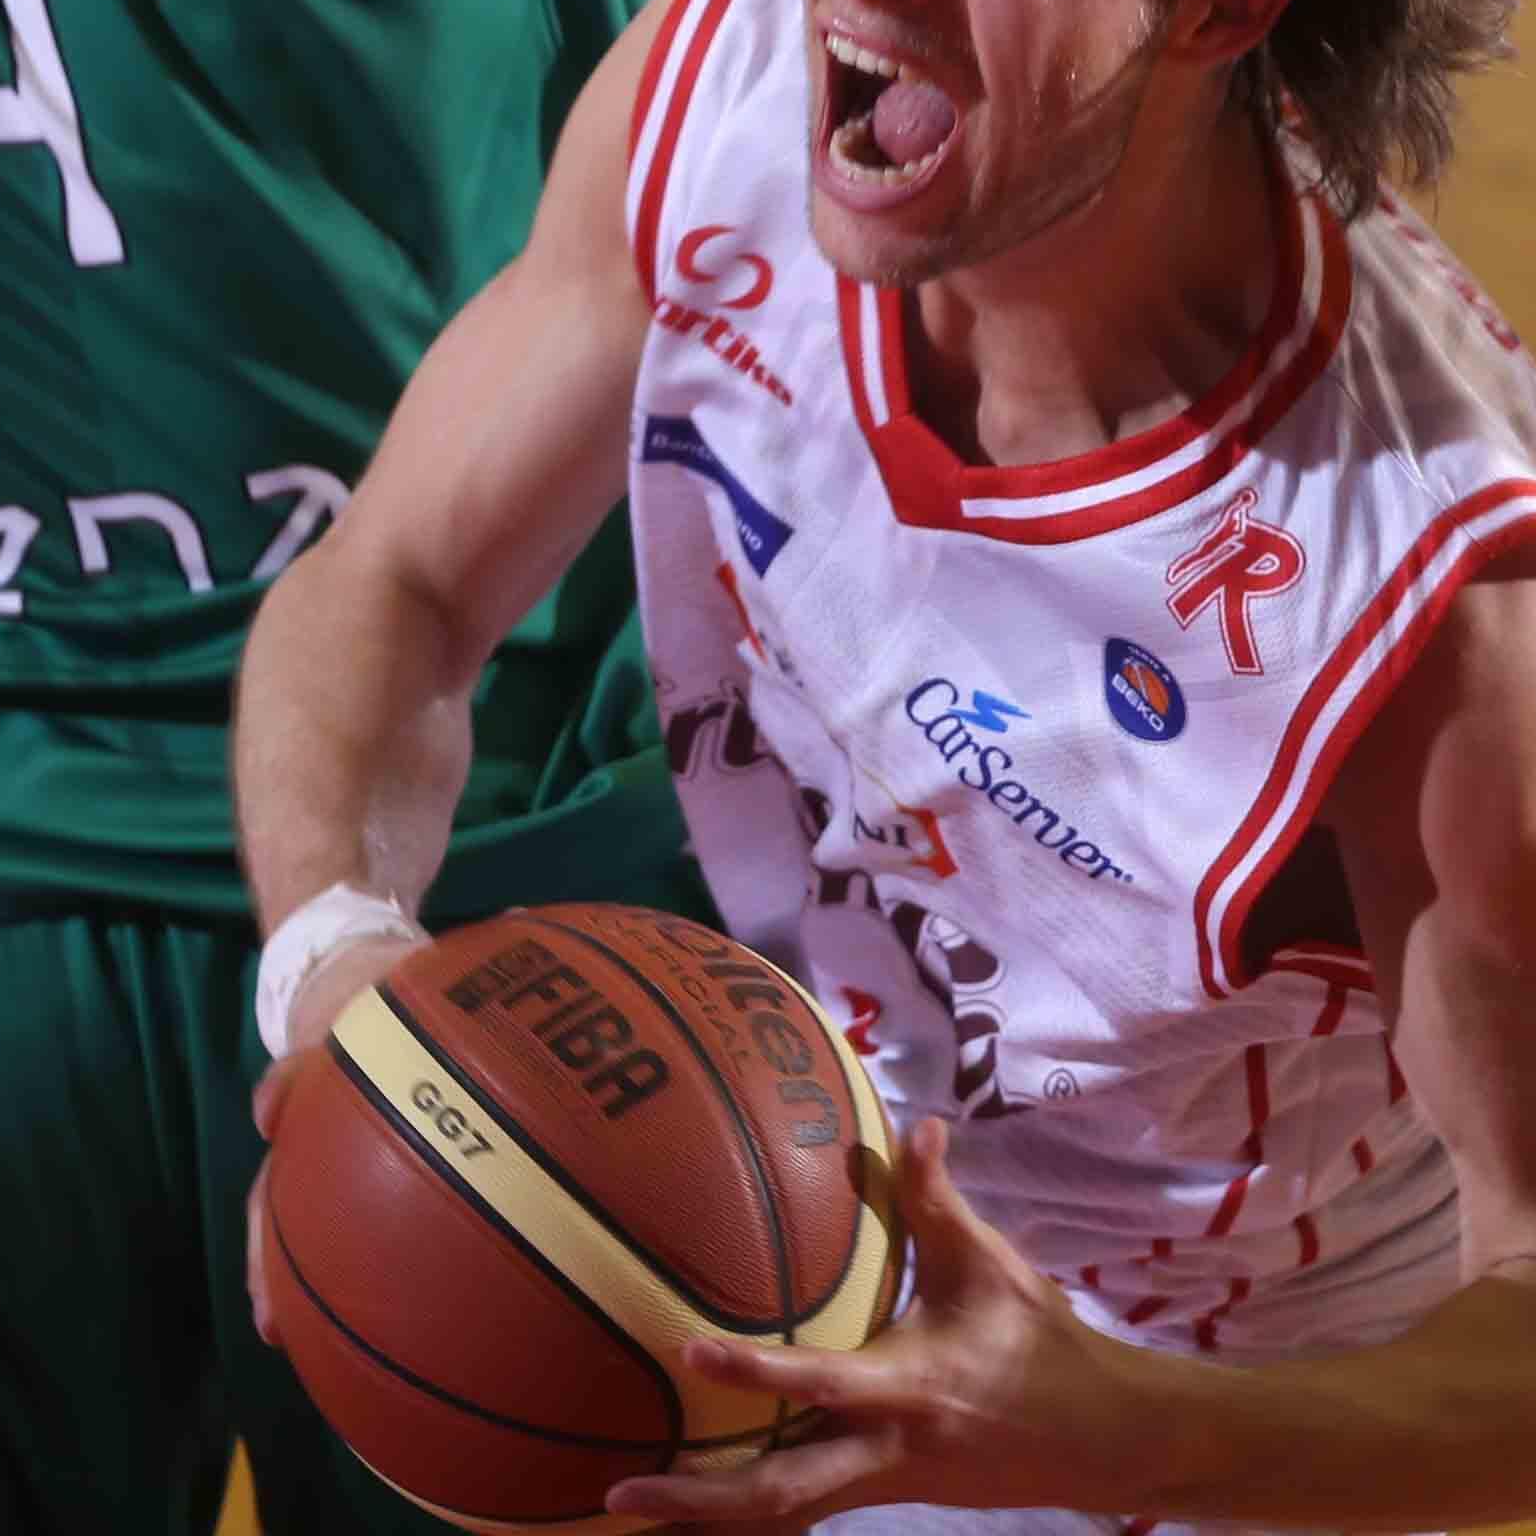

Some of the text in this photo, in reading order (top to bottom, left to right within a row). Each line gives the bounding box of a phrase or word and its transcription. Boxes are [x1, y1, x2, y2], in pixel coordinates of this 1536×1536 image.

[905, 676, 1124, 882] CarServer
[408, 1078, 497, 1162] GG7
[502, 961, 671, 1121] FIBA
